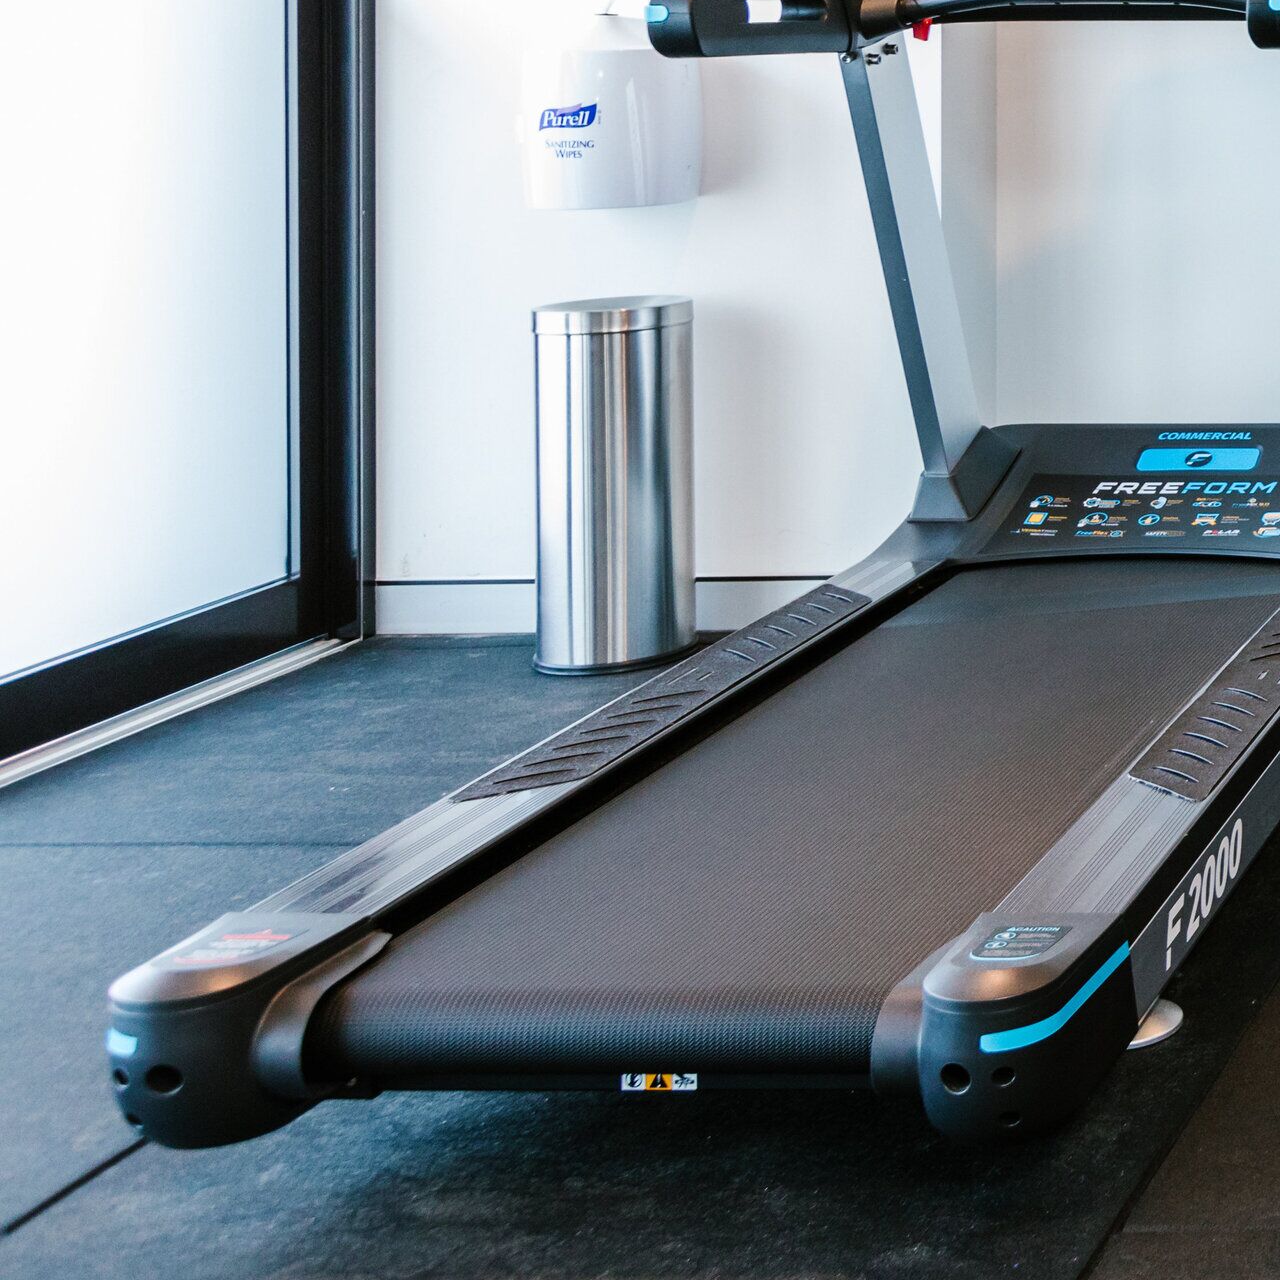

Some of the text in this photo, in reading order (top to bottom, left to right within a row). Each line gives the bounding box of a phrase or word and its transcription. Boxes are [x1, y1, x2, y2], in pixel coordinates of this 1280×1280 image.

[542, 110, 590, 127] Purell
[1157, 431, 1254, 441] COMMERCIAL
[1091, 481, 1278, 495] FREEFORM
[1166, 818, 1243, 971] F 2000
